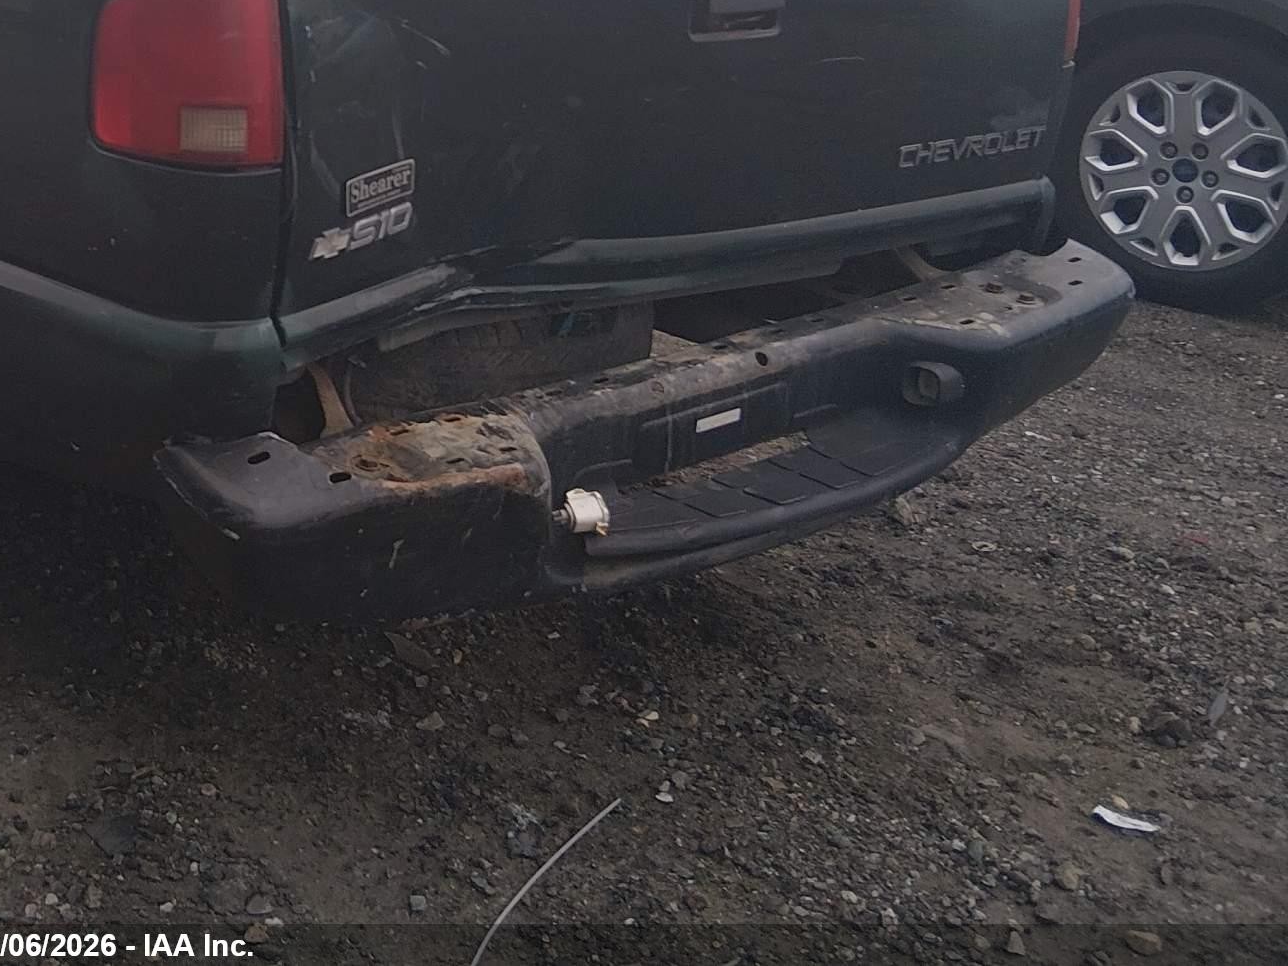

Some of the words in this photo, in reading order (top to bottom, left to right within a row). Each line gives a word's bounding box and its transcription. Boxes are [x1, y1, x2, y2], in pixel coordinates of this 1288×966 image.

[898, 125, 1047, 168] CHEVROLET
[350, 169, 411, 203] Shearer
[350, 201, 413, 250] S10
